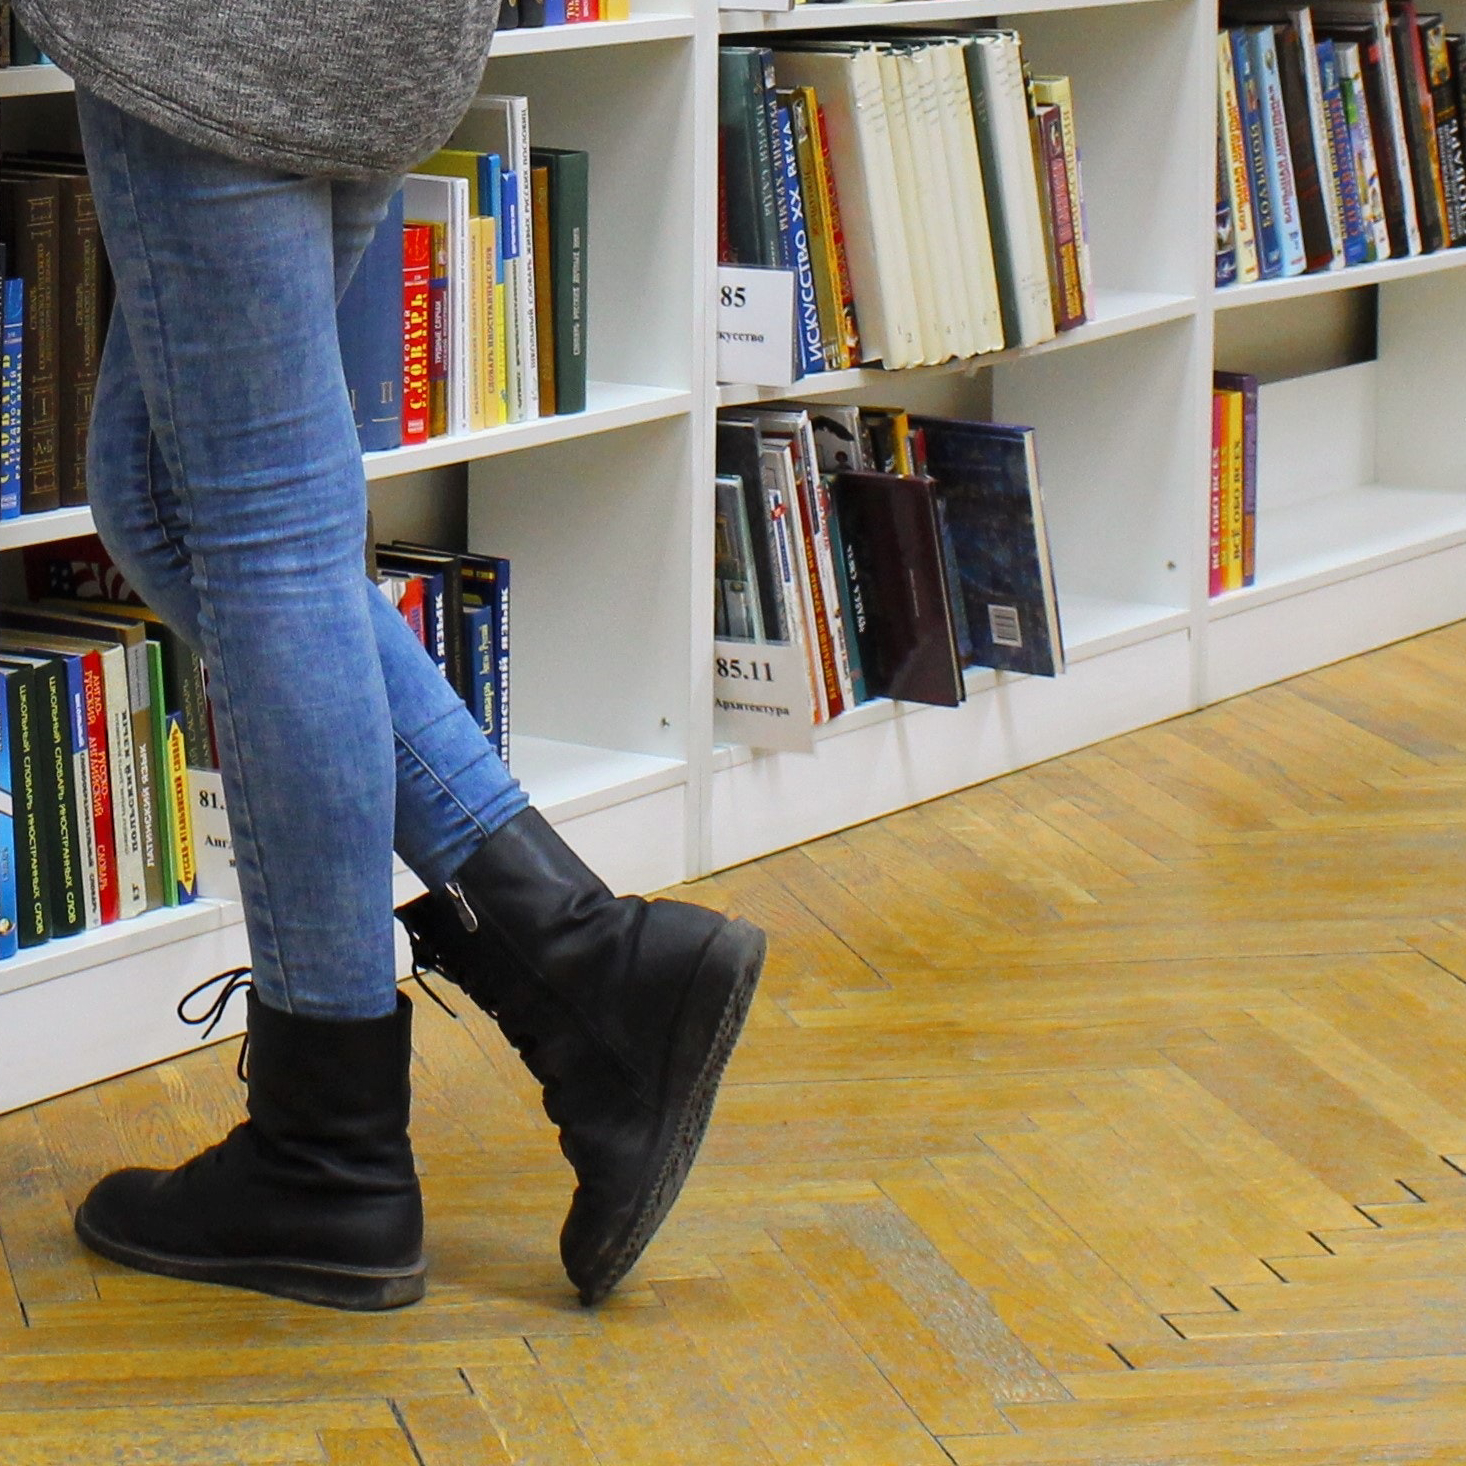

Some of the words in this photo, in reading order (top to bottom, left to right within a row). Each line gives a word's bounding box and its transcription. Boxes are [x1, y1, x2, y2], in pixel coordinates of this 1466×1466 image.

[782, 124, 800, 180] ВЕКА
[790, 187, 806, 222] ХХ
[720, 286, 747, 308] 85
[796, 228, 825, 362] ИСКУССТВО
[408, 292, 423, 410] СЛОВАРЬ
[716, 658, 774, 682] 85.11
[18, 684, 31, 753] ШКОЛЬНЫЙ
[48, 675, 62, 744] ШКОЛЬНЫЙ
[480, 681, 494, 736] Словарь
[715, 697, 791, 717] Архитектура
[23, 755, 34, 811] СЛОВАРЬ
[54, 746, 65, 801] СЛОВАРЬ
[138, 743, 149, 784] ЯЗЫК
[58, 803, 73, 889] ИНОСТРАННЫХ
[140, 786, 155, 867] ЛАТИНСКИЙ
[27, 813, 42, 899] ИНОСТРАННЫХ
[96, 844, 108, 891] СЛОВАРЬ
[34, 902, 45, 935] СЛОВ
[66, 891, 77, 924] СЛОВ
